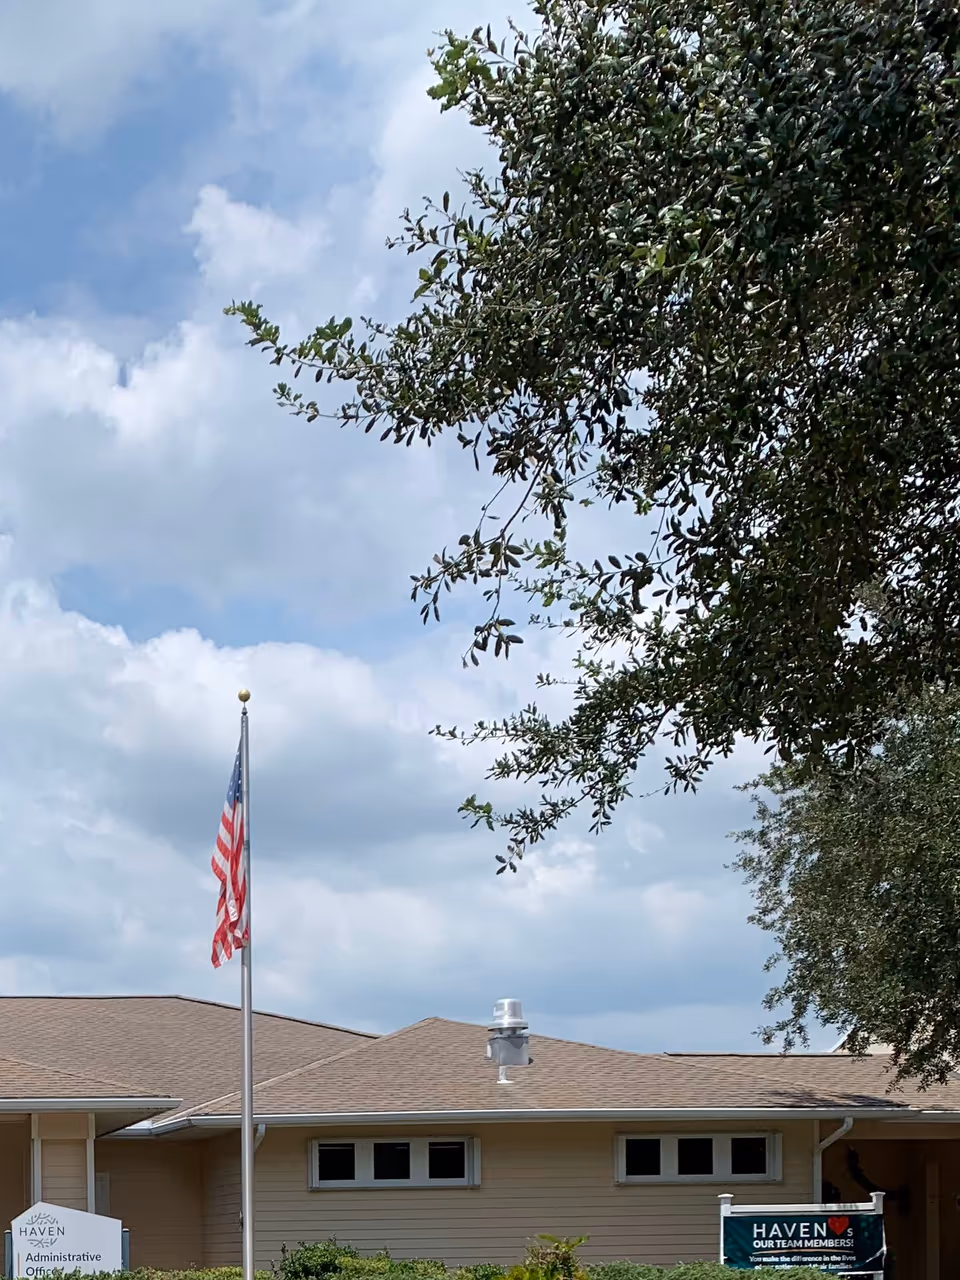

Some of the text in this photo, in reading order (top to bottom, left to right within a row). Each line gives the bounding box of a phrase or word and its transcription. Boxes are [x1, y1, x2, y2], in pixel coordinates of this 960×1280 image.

[19, 1226, 65, 1236] HAVEN
[753, 1222, 826, 1238] HAVEN
[753, 1238, 854, 1248] OUR TEAM MEMBERS!
[25, 1252, 102, 1262] Administrative
